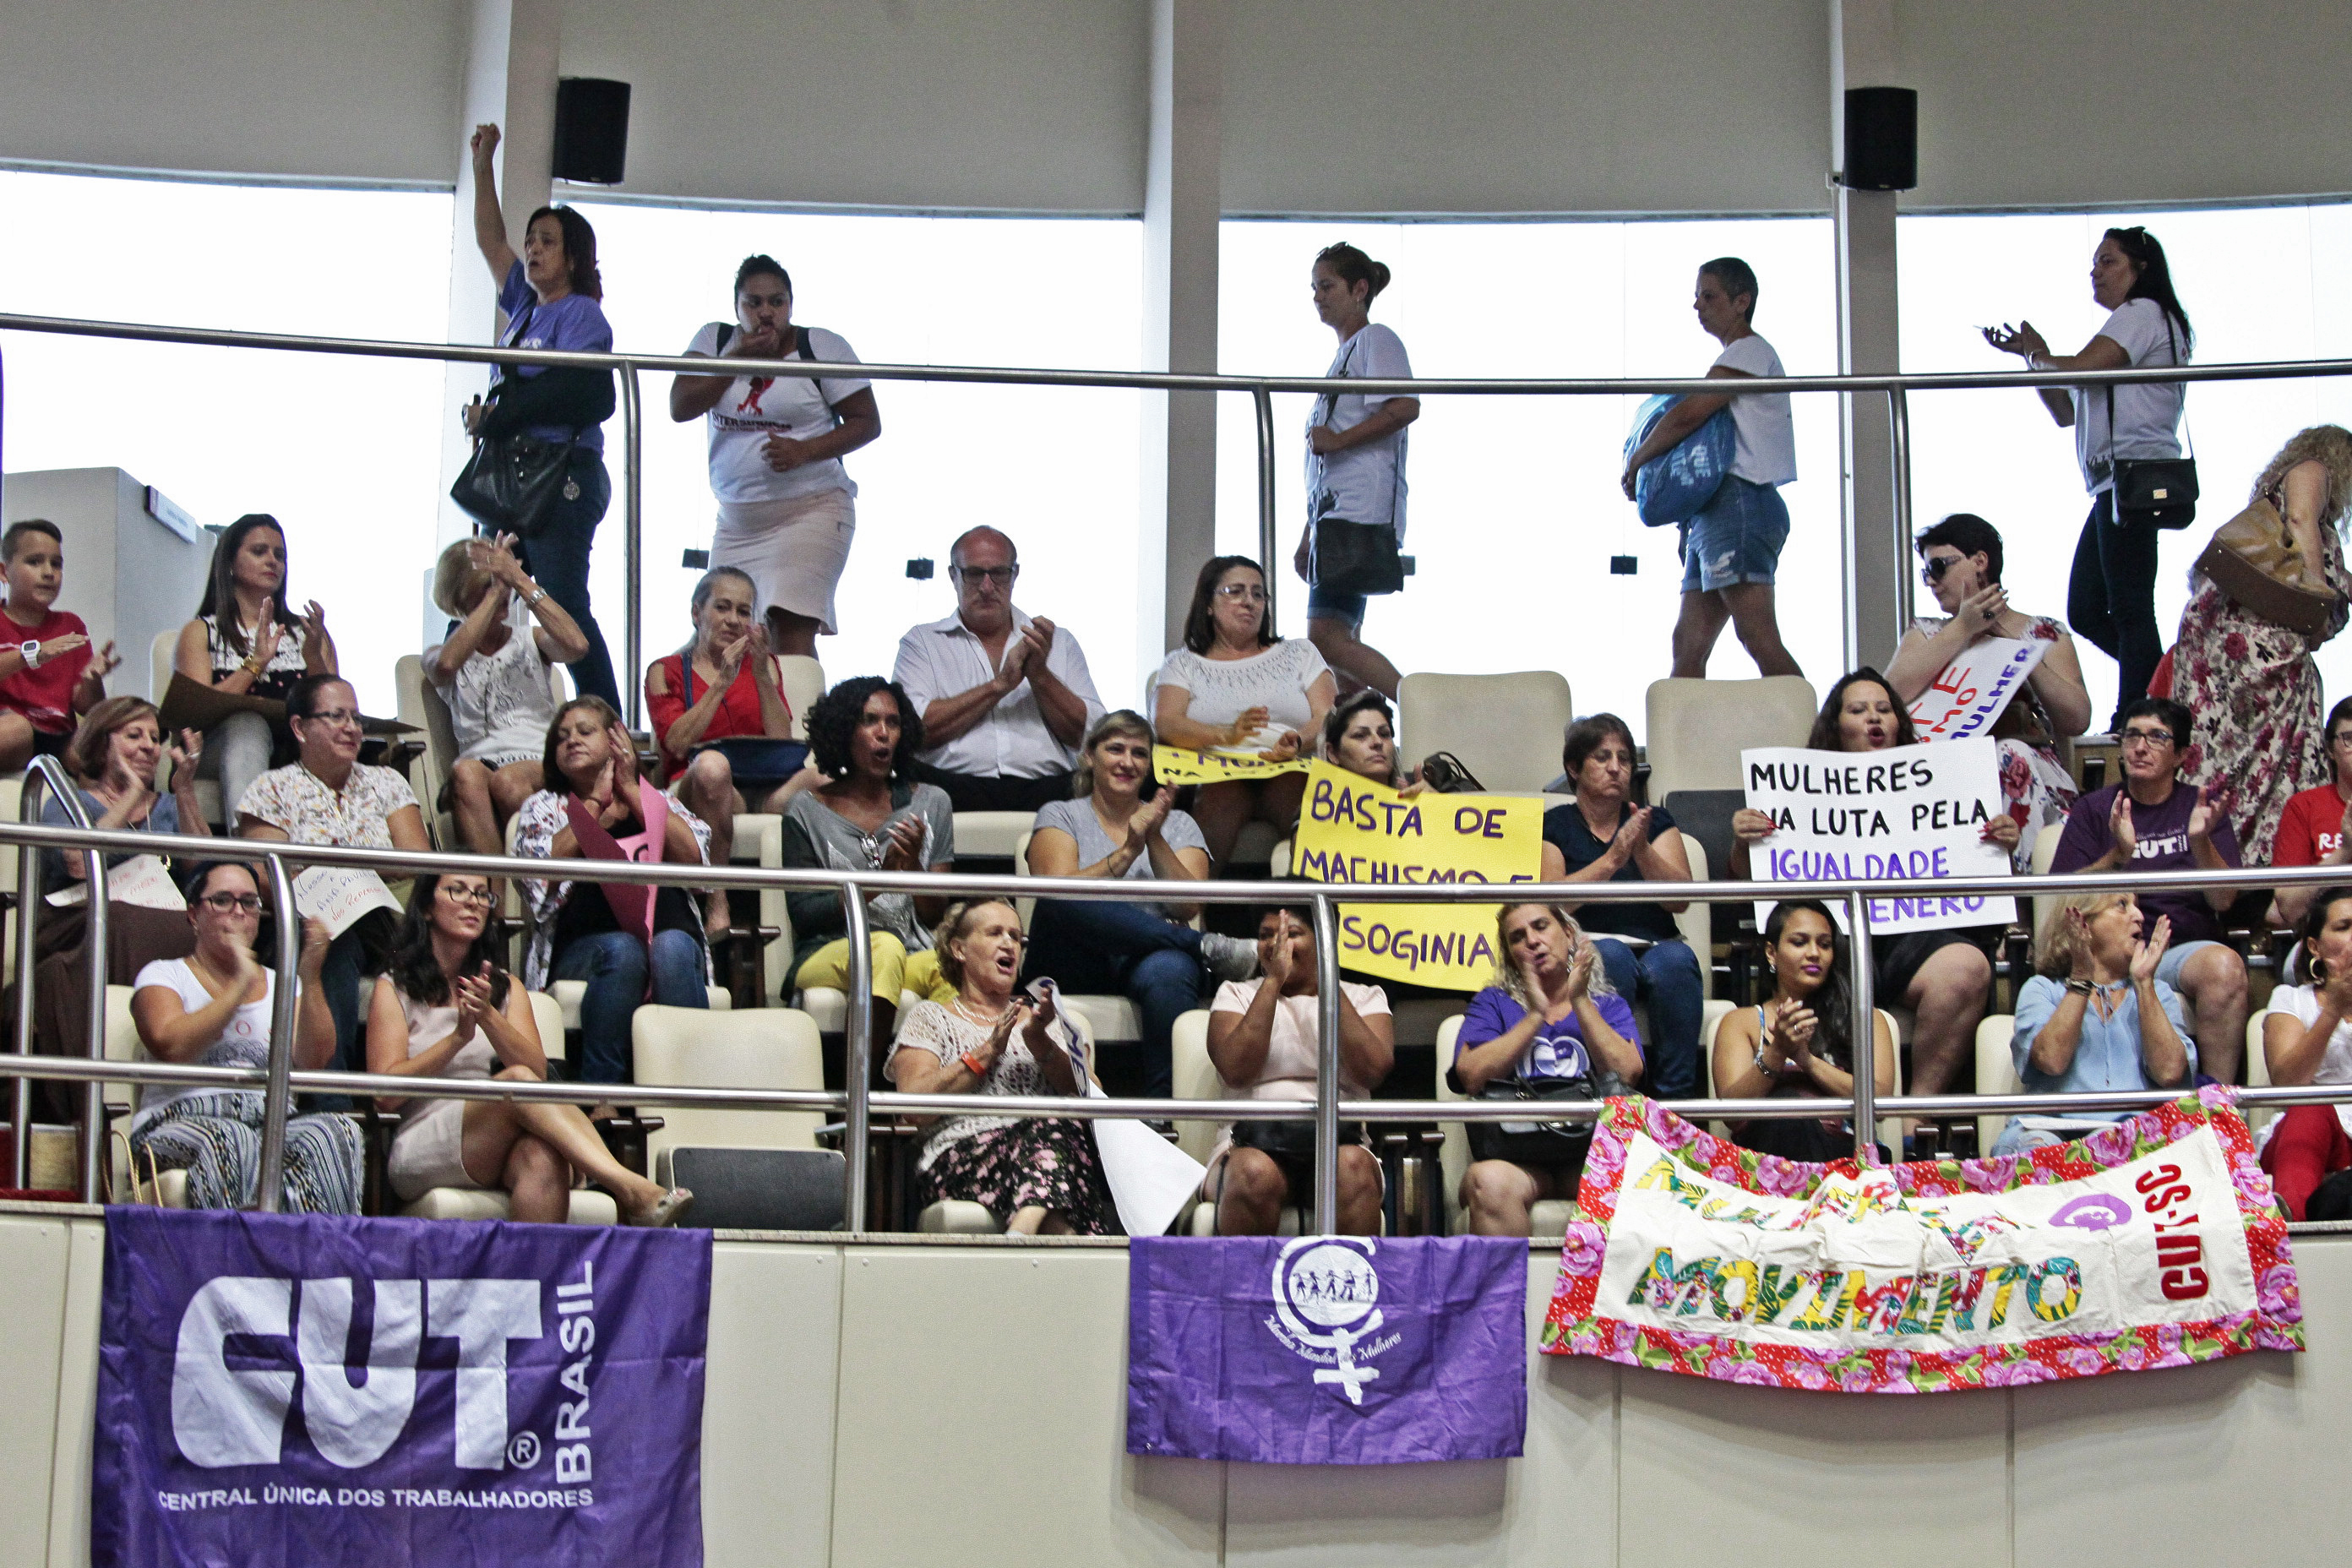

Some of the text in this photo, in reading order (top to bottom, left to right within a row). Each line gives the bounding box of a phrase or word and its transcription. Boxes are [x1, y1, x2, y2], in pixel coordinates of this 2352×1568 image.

[1750, 759, 1934, 795] MULHERES
[1309, 779, 1507, 839] BASTA DE
[1811, 807, 1891, 838] LUTA
[1911, 798, 1990, 831] PELA
[1770, 847, 1950, 880] IGUALDADE
[1843, 896, 1985, 923] ENER
[1626, 1246, 2082, 1337] MOVIMENTO
[171, 1275, 544, 1471] CUT
[555, 1260, 596, 1484] BRASIL
[158, 1481, 594, 1511] CENTRAL ÚNICA DOS TRABALHADORES
